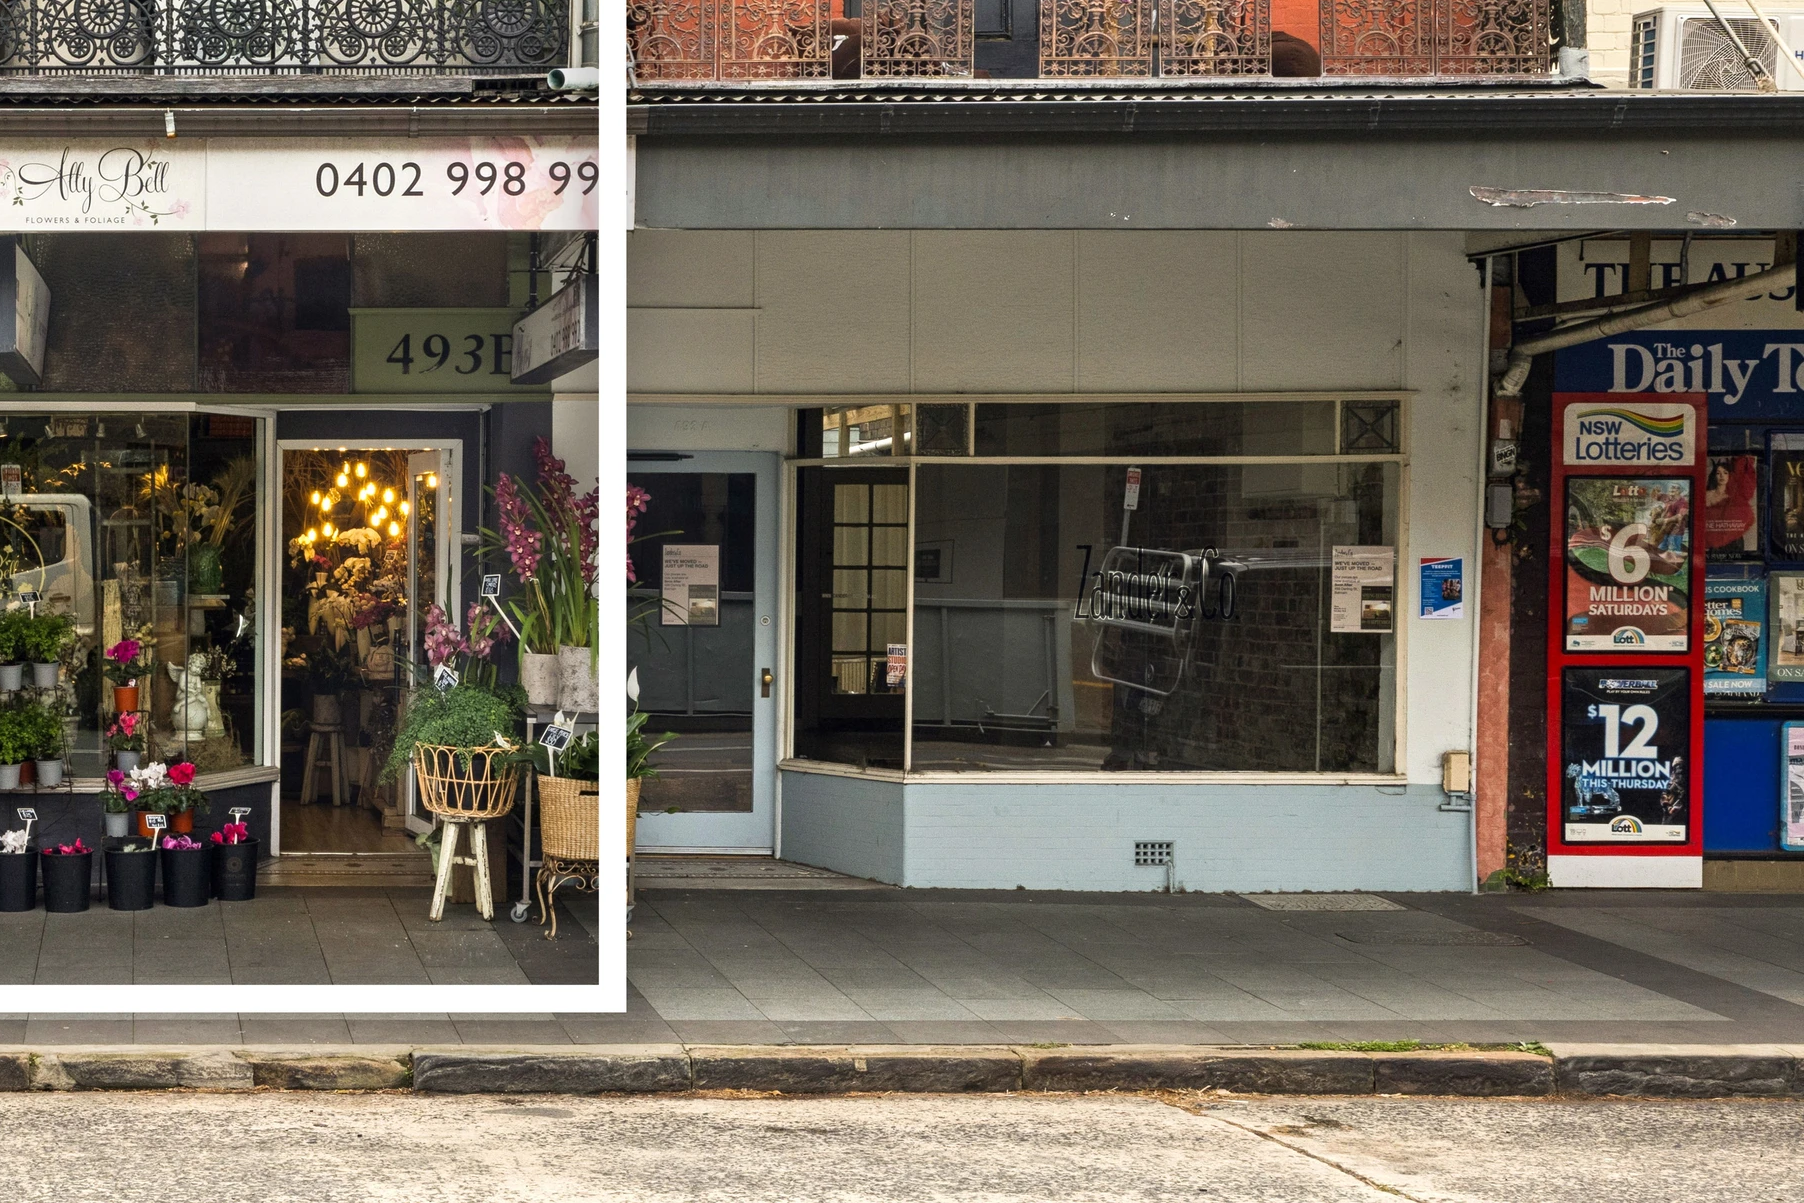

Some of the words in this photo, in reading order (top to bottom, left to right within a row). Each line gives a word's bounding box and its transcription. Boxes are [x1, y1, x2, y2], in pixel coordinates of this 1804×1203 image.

[19, 147, 96, 214] Ally
[98, 147, 170, 202] Bell
[316, 162, 424, 197] 0402
[447, 162, 526, 197] 998
[550, 162, 599, 197] 99
[1653, 343, 1685, 358] The
[1607, 342, 1759, 404] Daily
[1580, 421, 1622, 435] NSW
[1576, 437, 1684, 460] Lotteries
[1589, 604, 1668, 616] SATURDAYS
[1777, 668, 1793, 677] ON
[1582, 760, 1670, 777] MILLION
[1611, 779, 1670, 789] THURSDAY
